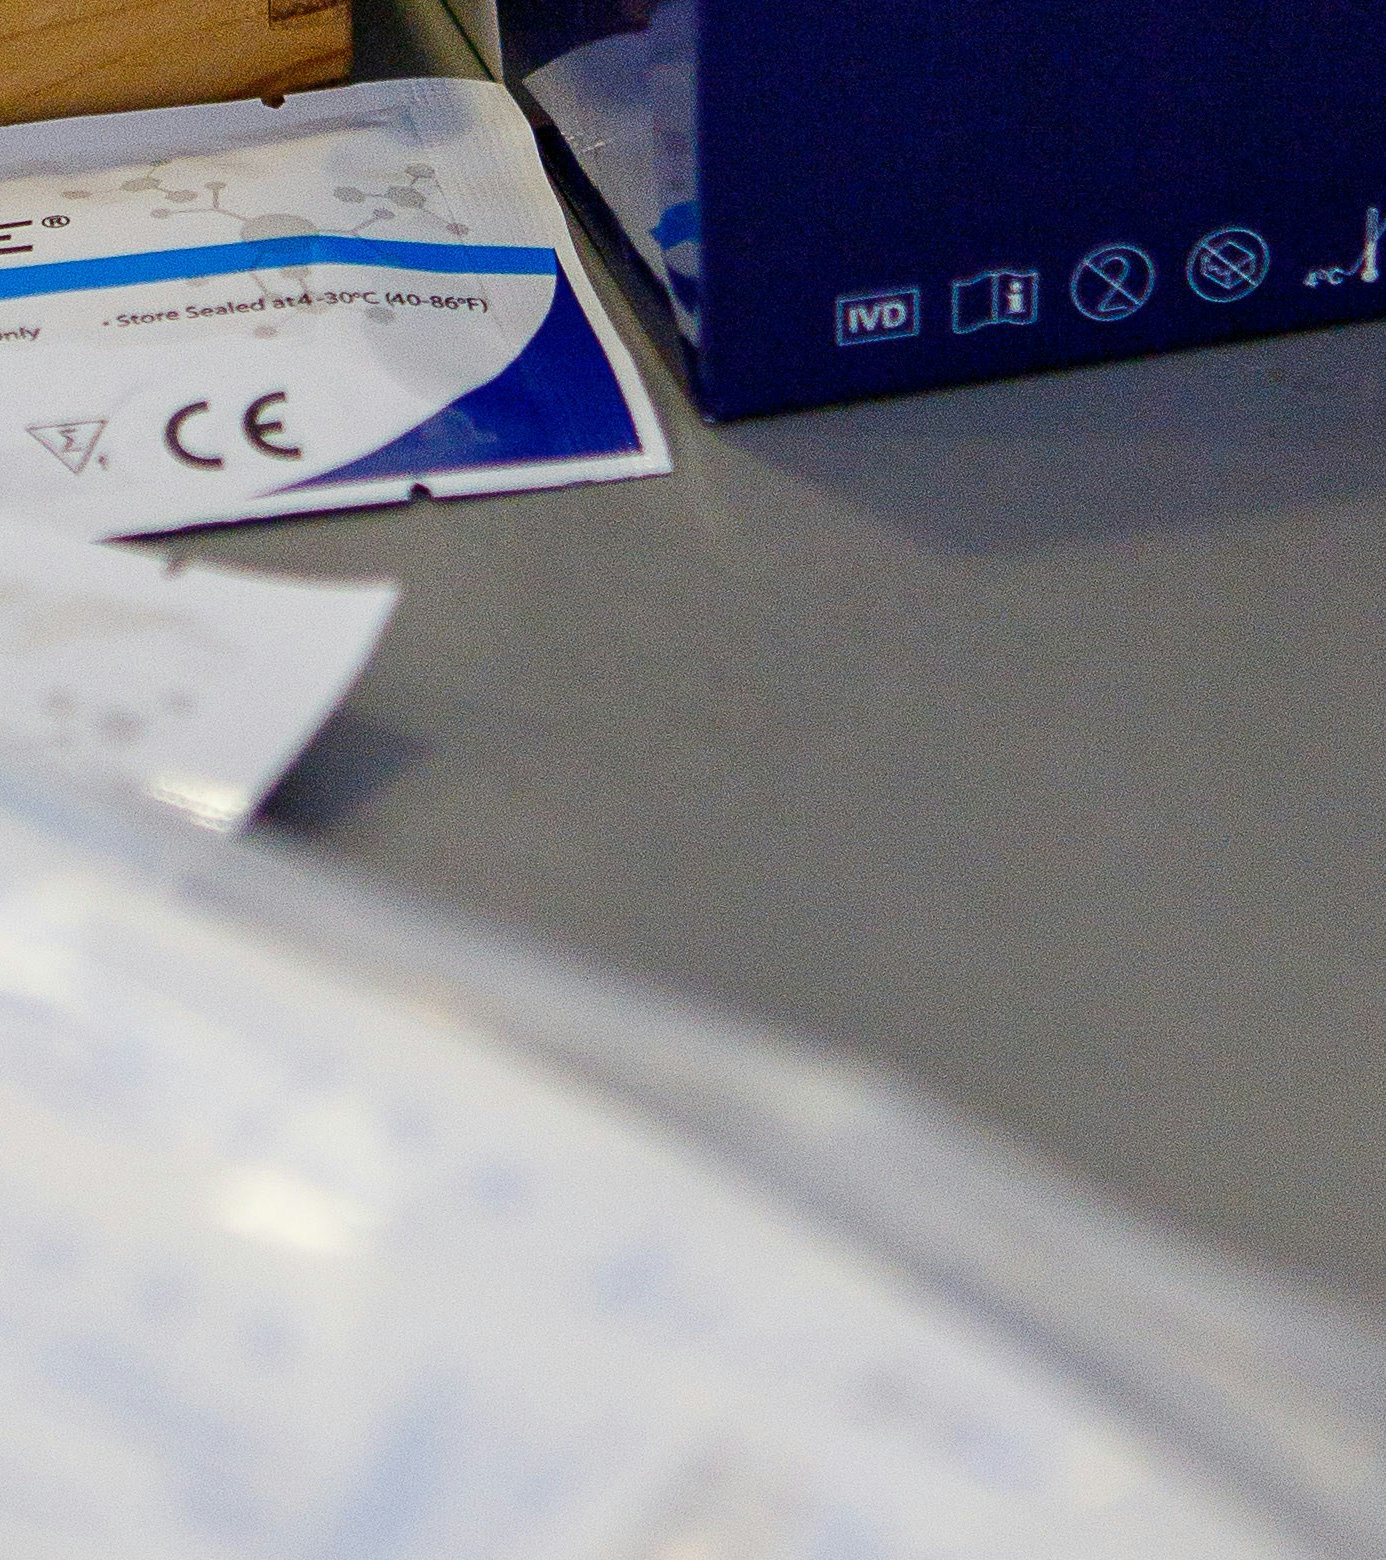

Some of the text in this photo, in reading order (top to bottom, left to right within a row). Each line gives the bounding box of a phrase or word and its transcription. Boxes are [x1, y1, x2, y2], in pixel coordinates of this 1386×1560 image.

[116, 309, 179, 329] Store
[187, 296, 265, 319] Sealed
[846, 300, 907, 334] IVD
